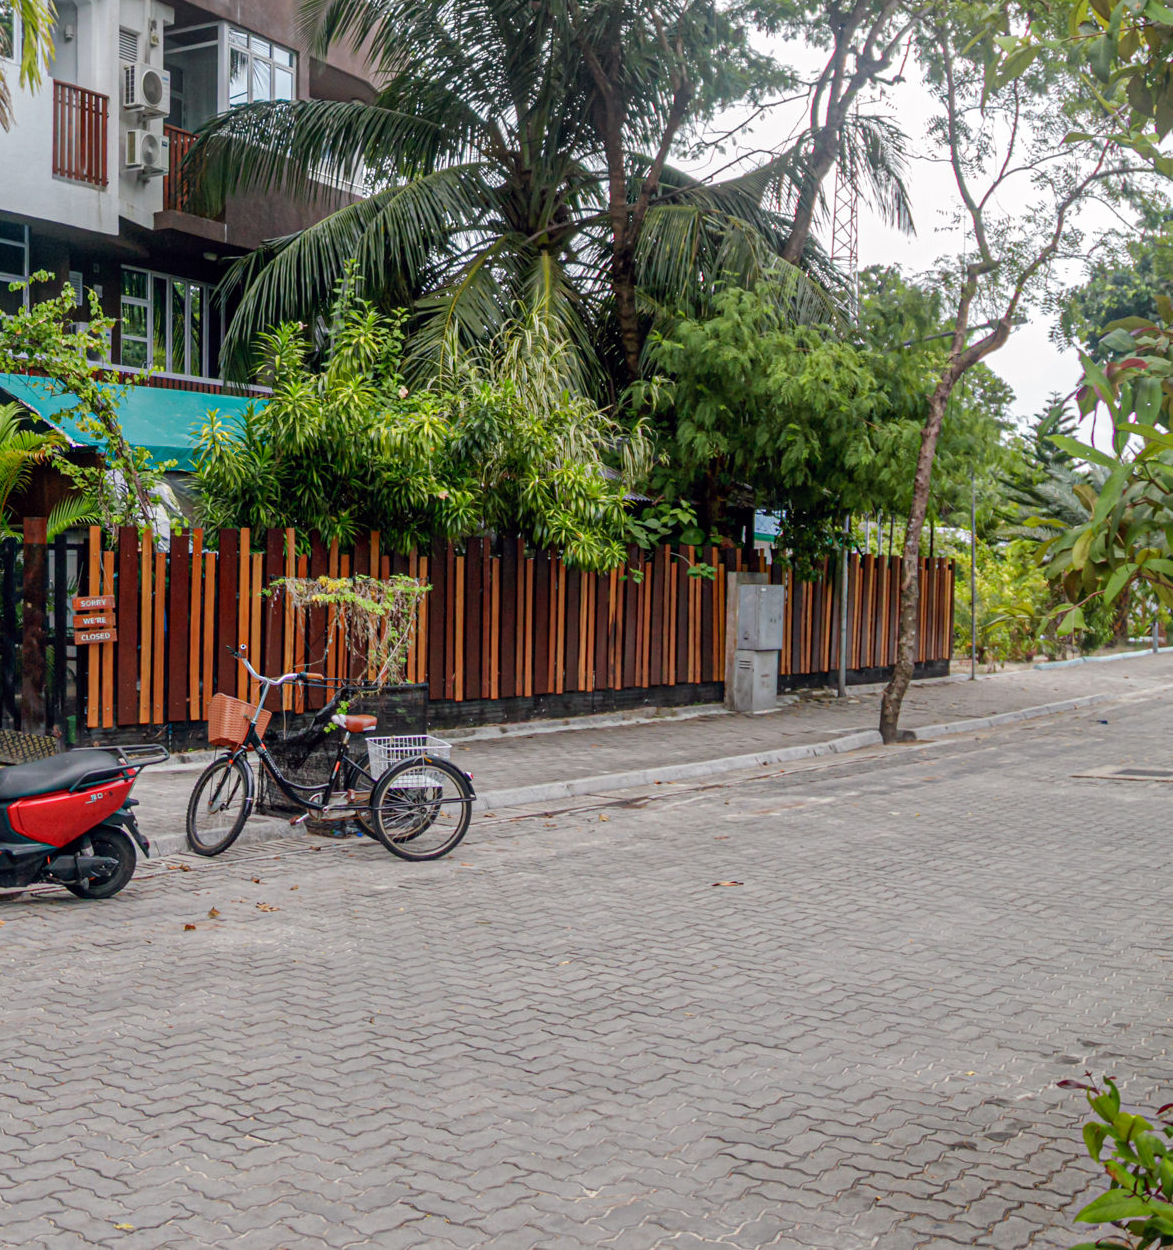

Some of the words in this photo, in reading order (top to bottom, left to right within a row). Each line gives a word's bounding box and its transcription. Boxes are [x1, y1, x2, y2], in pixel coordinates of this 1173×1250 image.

[80, 599, 107, 607] SORRY
[82, 616, 107, 625] WE'RE
[80, 632, 111, 641] CLOSED
